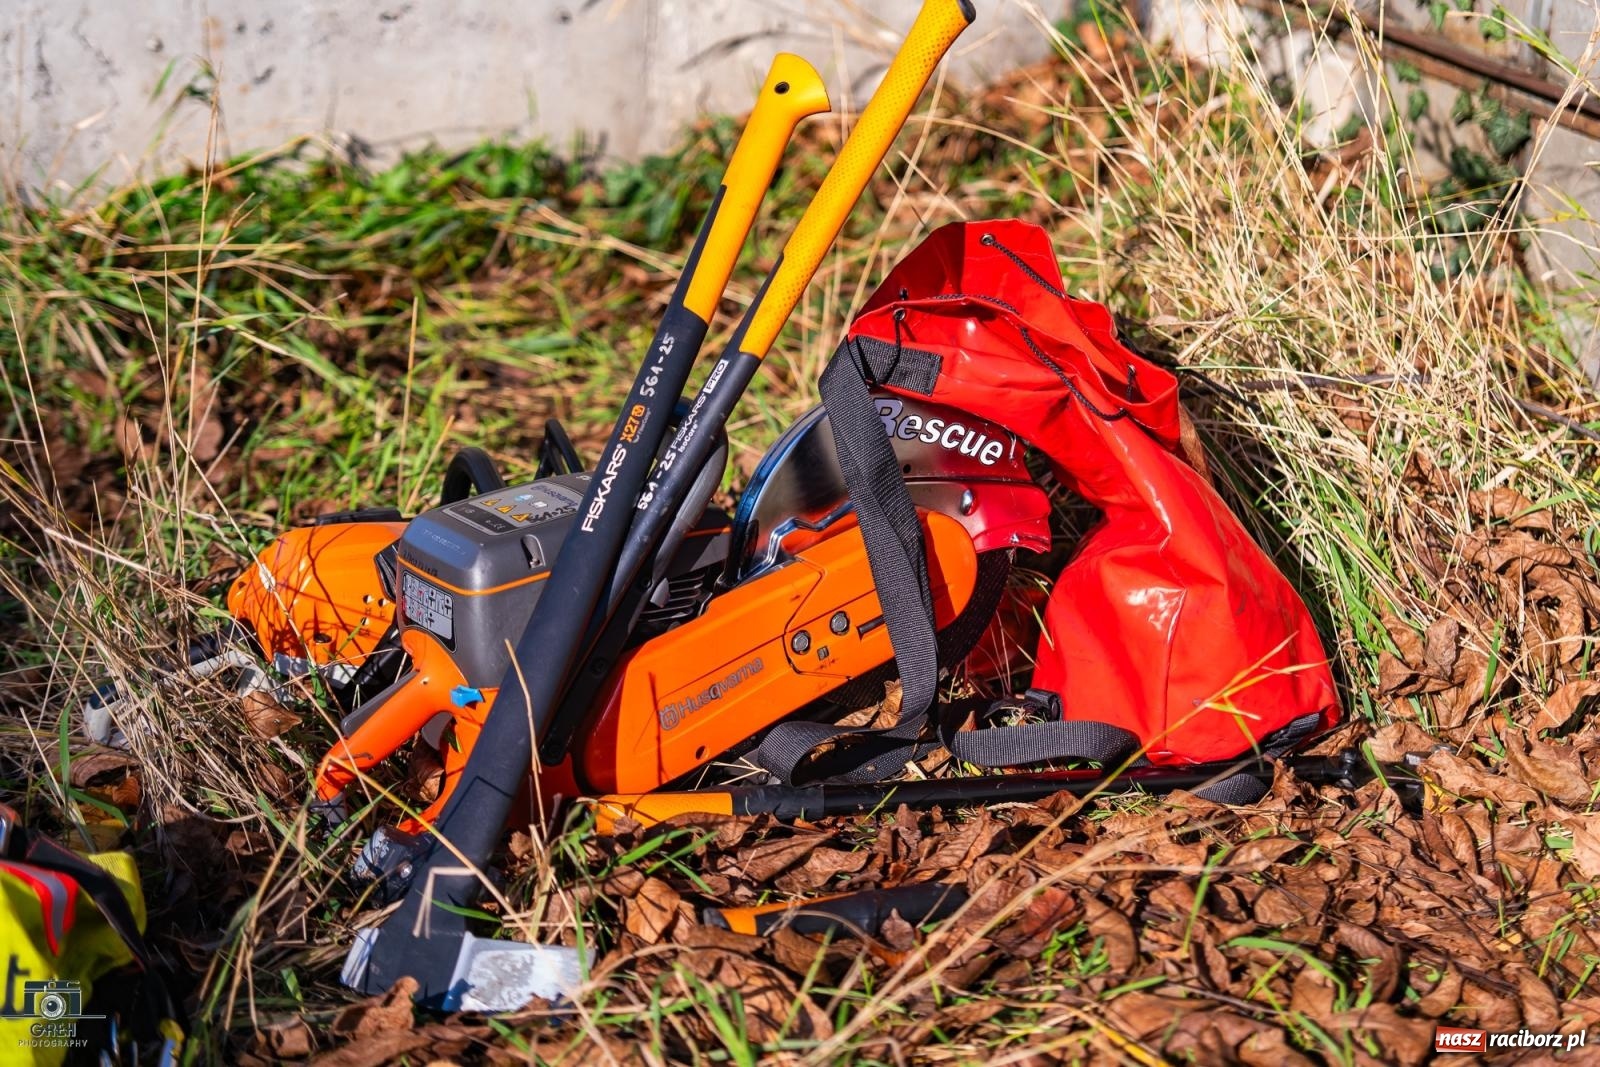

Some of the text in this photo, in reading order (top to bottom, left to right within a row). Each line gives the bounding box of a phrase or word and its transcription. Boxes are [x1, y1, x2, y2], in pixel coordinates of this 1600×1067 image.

[704, 360, 727, 393] PRO
[873, 397, 1004, 466] Rescue
[679, 657, 764, 719] Husqvarna
